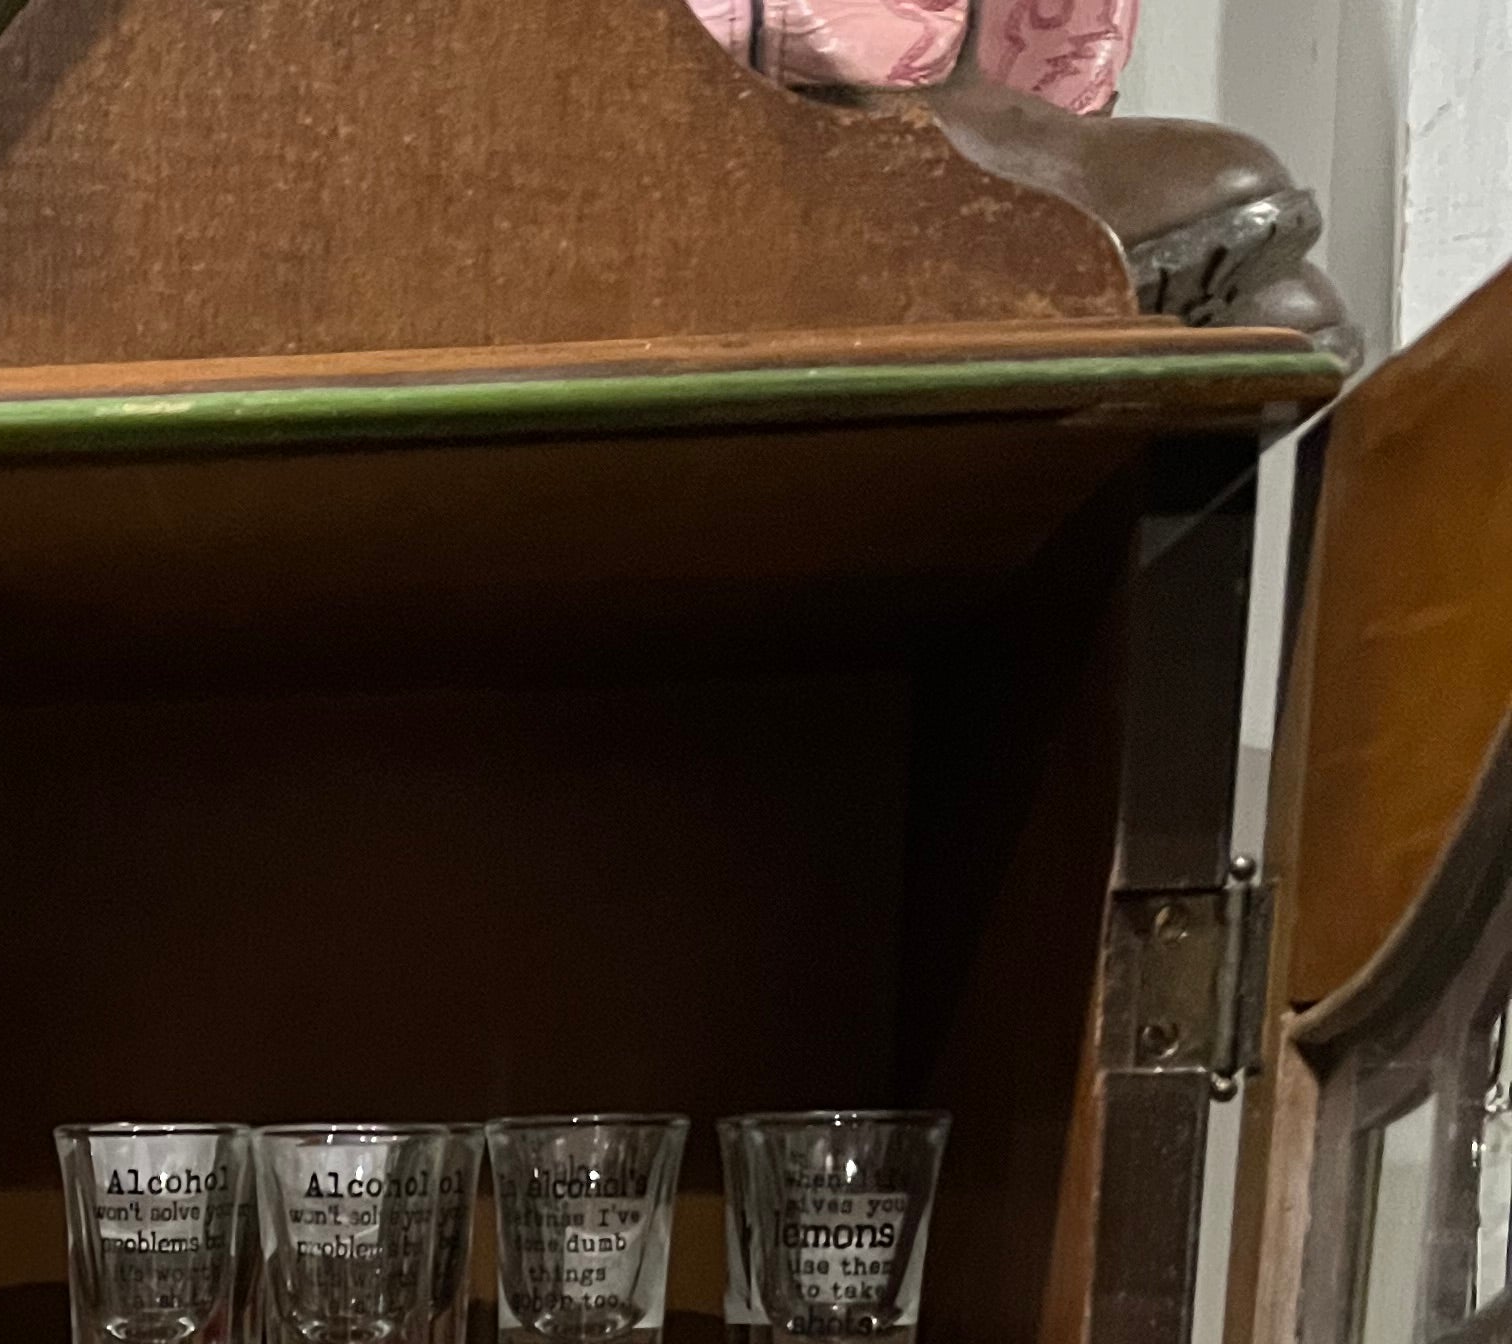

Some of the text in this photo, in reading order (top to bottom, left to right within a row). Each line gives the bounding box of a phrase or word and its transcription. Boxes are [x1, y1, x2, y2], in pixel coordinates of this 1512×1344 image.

[106, 1165, 229, 1197] Alcohol
[304, 1170, 430, 1199] Alcohol
[93, 1201, 143, 1222] won't
[150, 1201, 200, 1222] solve
[101, 1230, 200, 1258] problems
[566, 1232, 627, 1254] dumb
[774, 1210, 895, 1250] lemons
[528, 1262, 607, 1288] things
